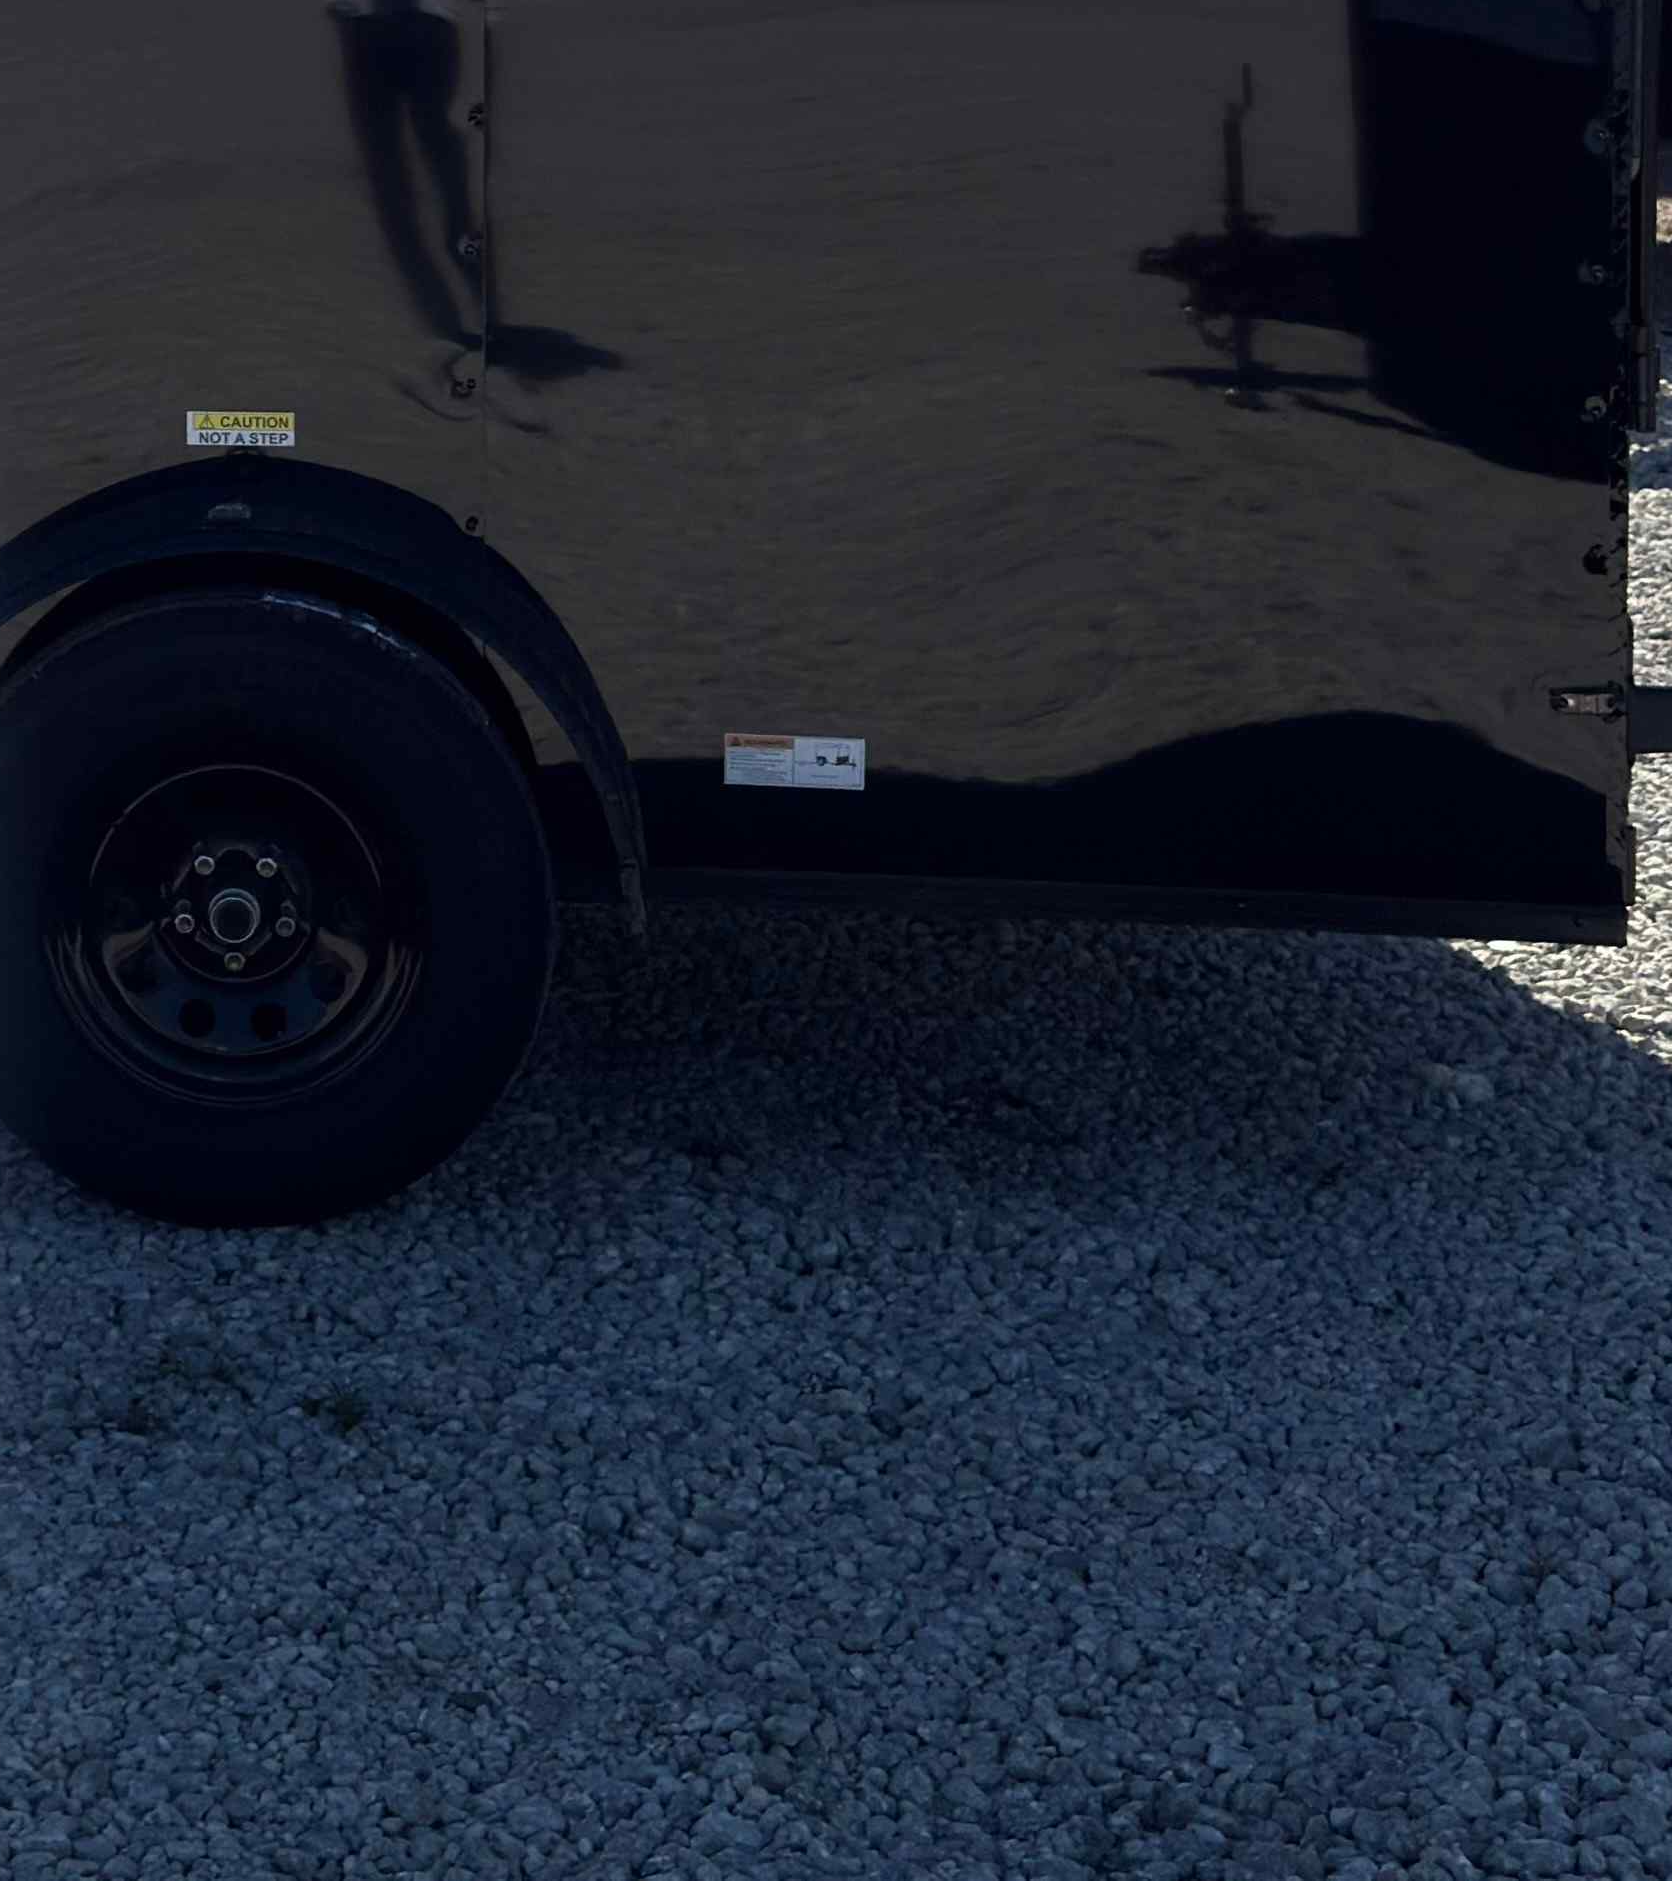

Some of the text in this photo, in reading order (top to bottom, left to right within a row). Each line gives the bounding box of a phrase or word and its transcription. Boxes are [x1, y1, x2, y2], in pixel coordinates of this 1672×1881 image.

[220, 416, 289, 429] CAUTION
[199, 432, 289, 445] NOT A STEP
